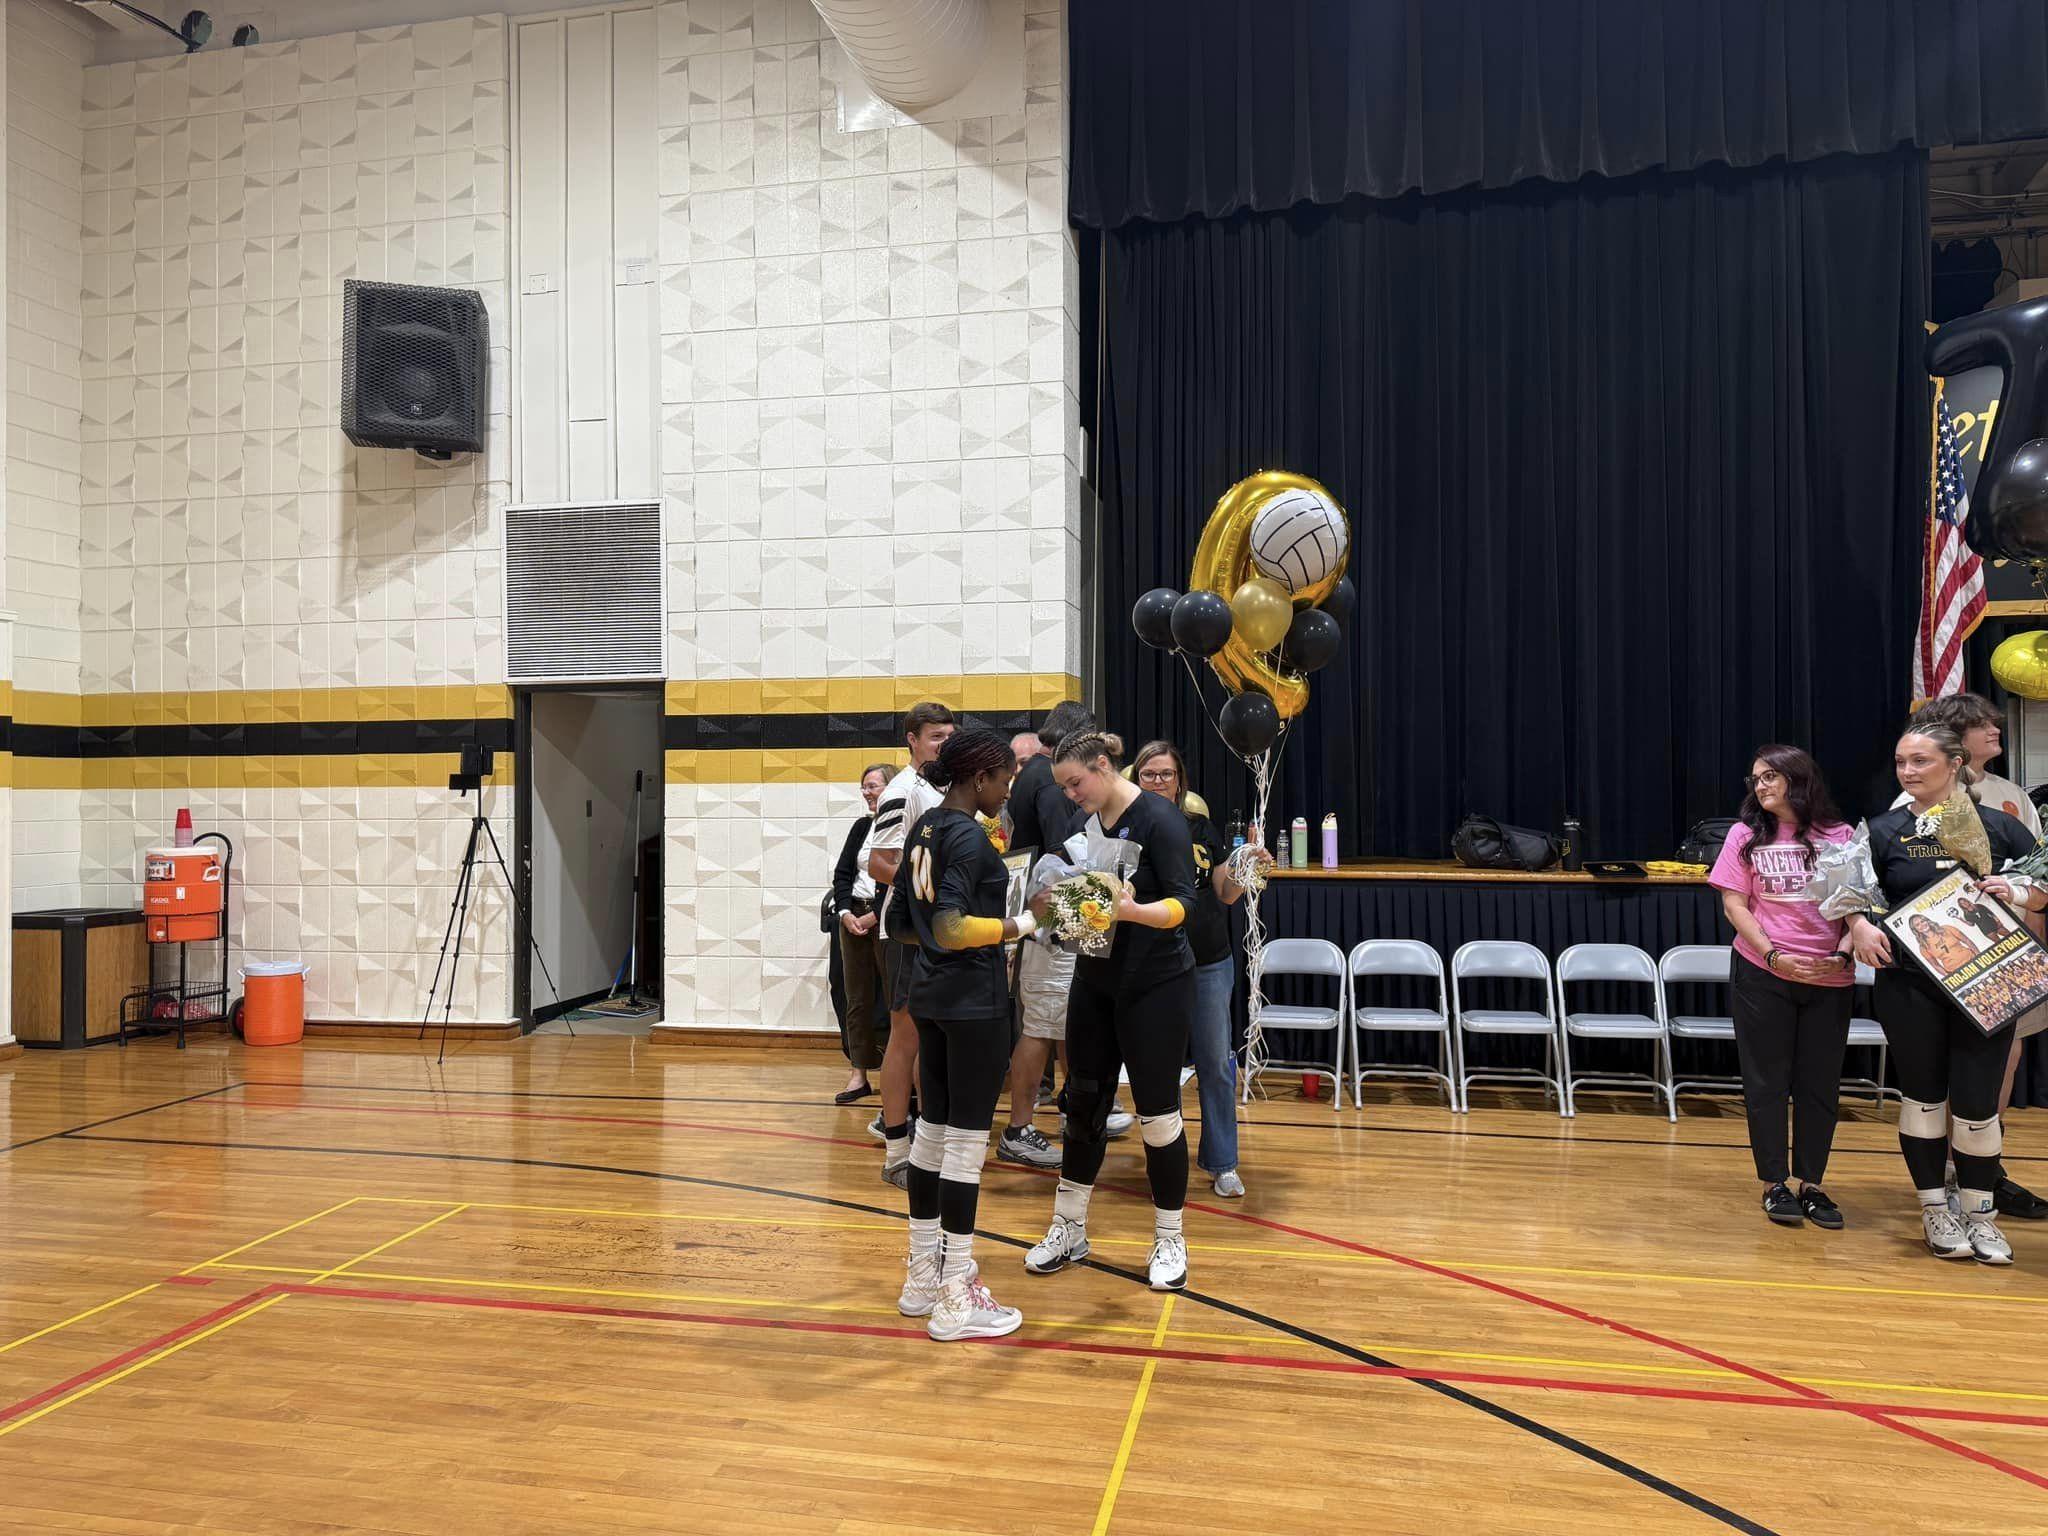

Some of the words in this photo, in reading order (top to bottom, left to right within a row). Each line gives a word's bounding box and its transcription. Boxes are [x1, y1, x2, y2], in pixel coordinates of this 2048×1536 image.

[1758, 875, 1814, 894] TE
[1943, 963, 1980, 990] TROJAN
[1976, 931, 2030, 969] VOLLEYBALL
